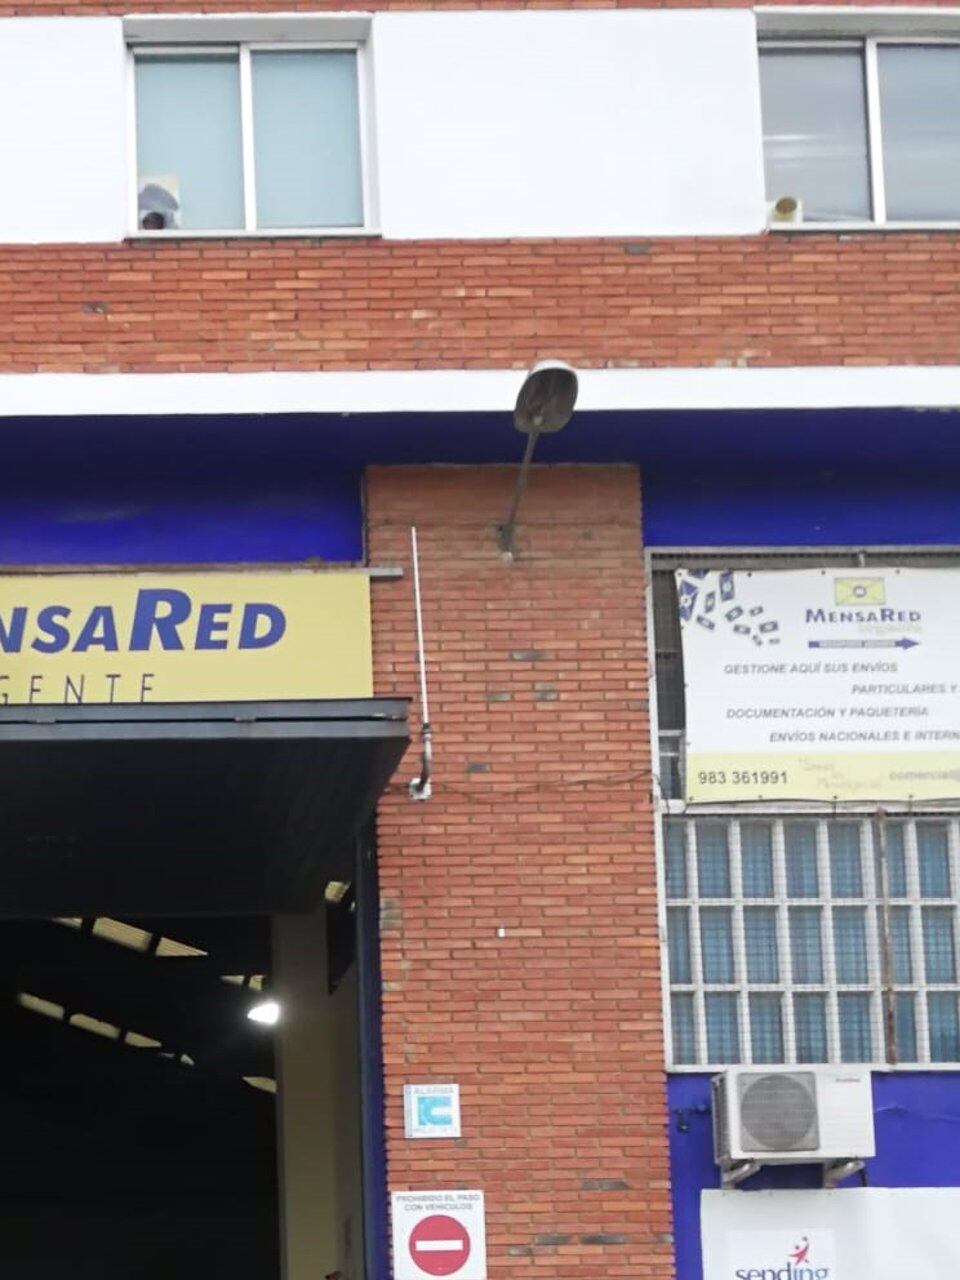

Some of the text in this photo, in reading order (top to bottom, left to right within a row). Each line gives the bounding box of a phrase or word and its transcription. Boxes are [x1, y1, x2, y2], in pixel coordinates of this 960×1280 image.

[724, 660, 898, 675] GESTIONE AQUÍ SUS ENVÍOS
[852, 684, 958, 695] PARTICULARES Y
[727, 706, 929, 719] DOCUMENTACIÓN Y PAQUETERÍA
[770, 730, 815, 743] ENVÍOS
[819, 731, 899, 742] NACIONALES
[904, 731, 911, 741] E
[698, 771, 788, 784] 983 361991
